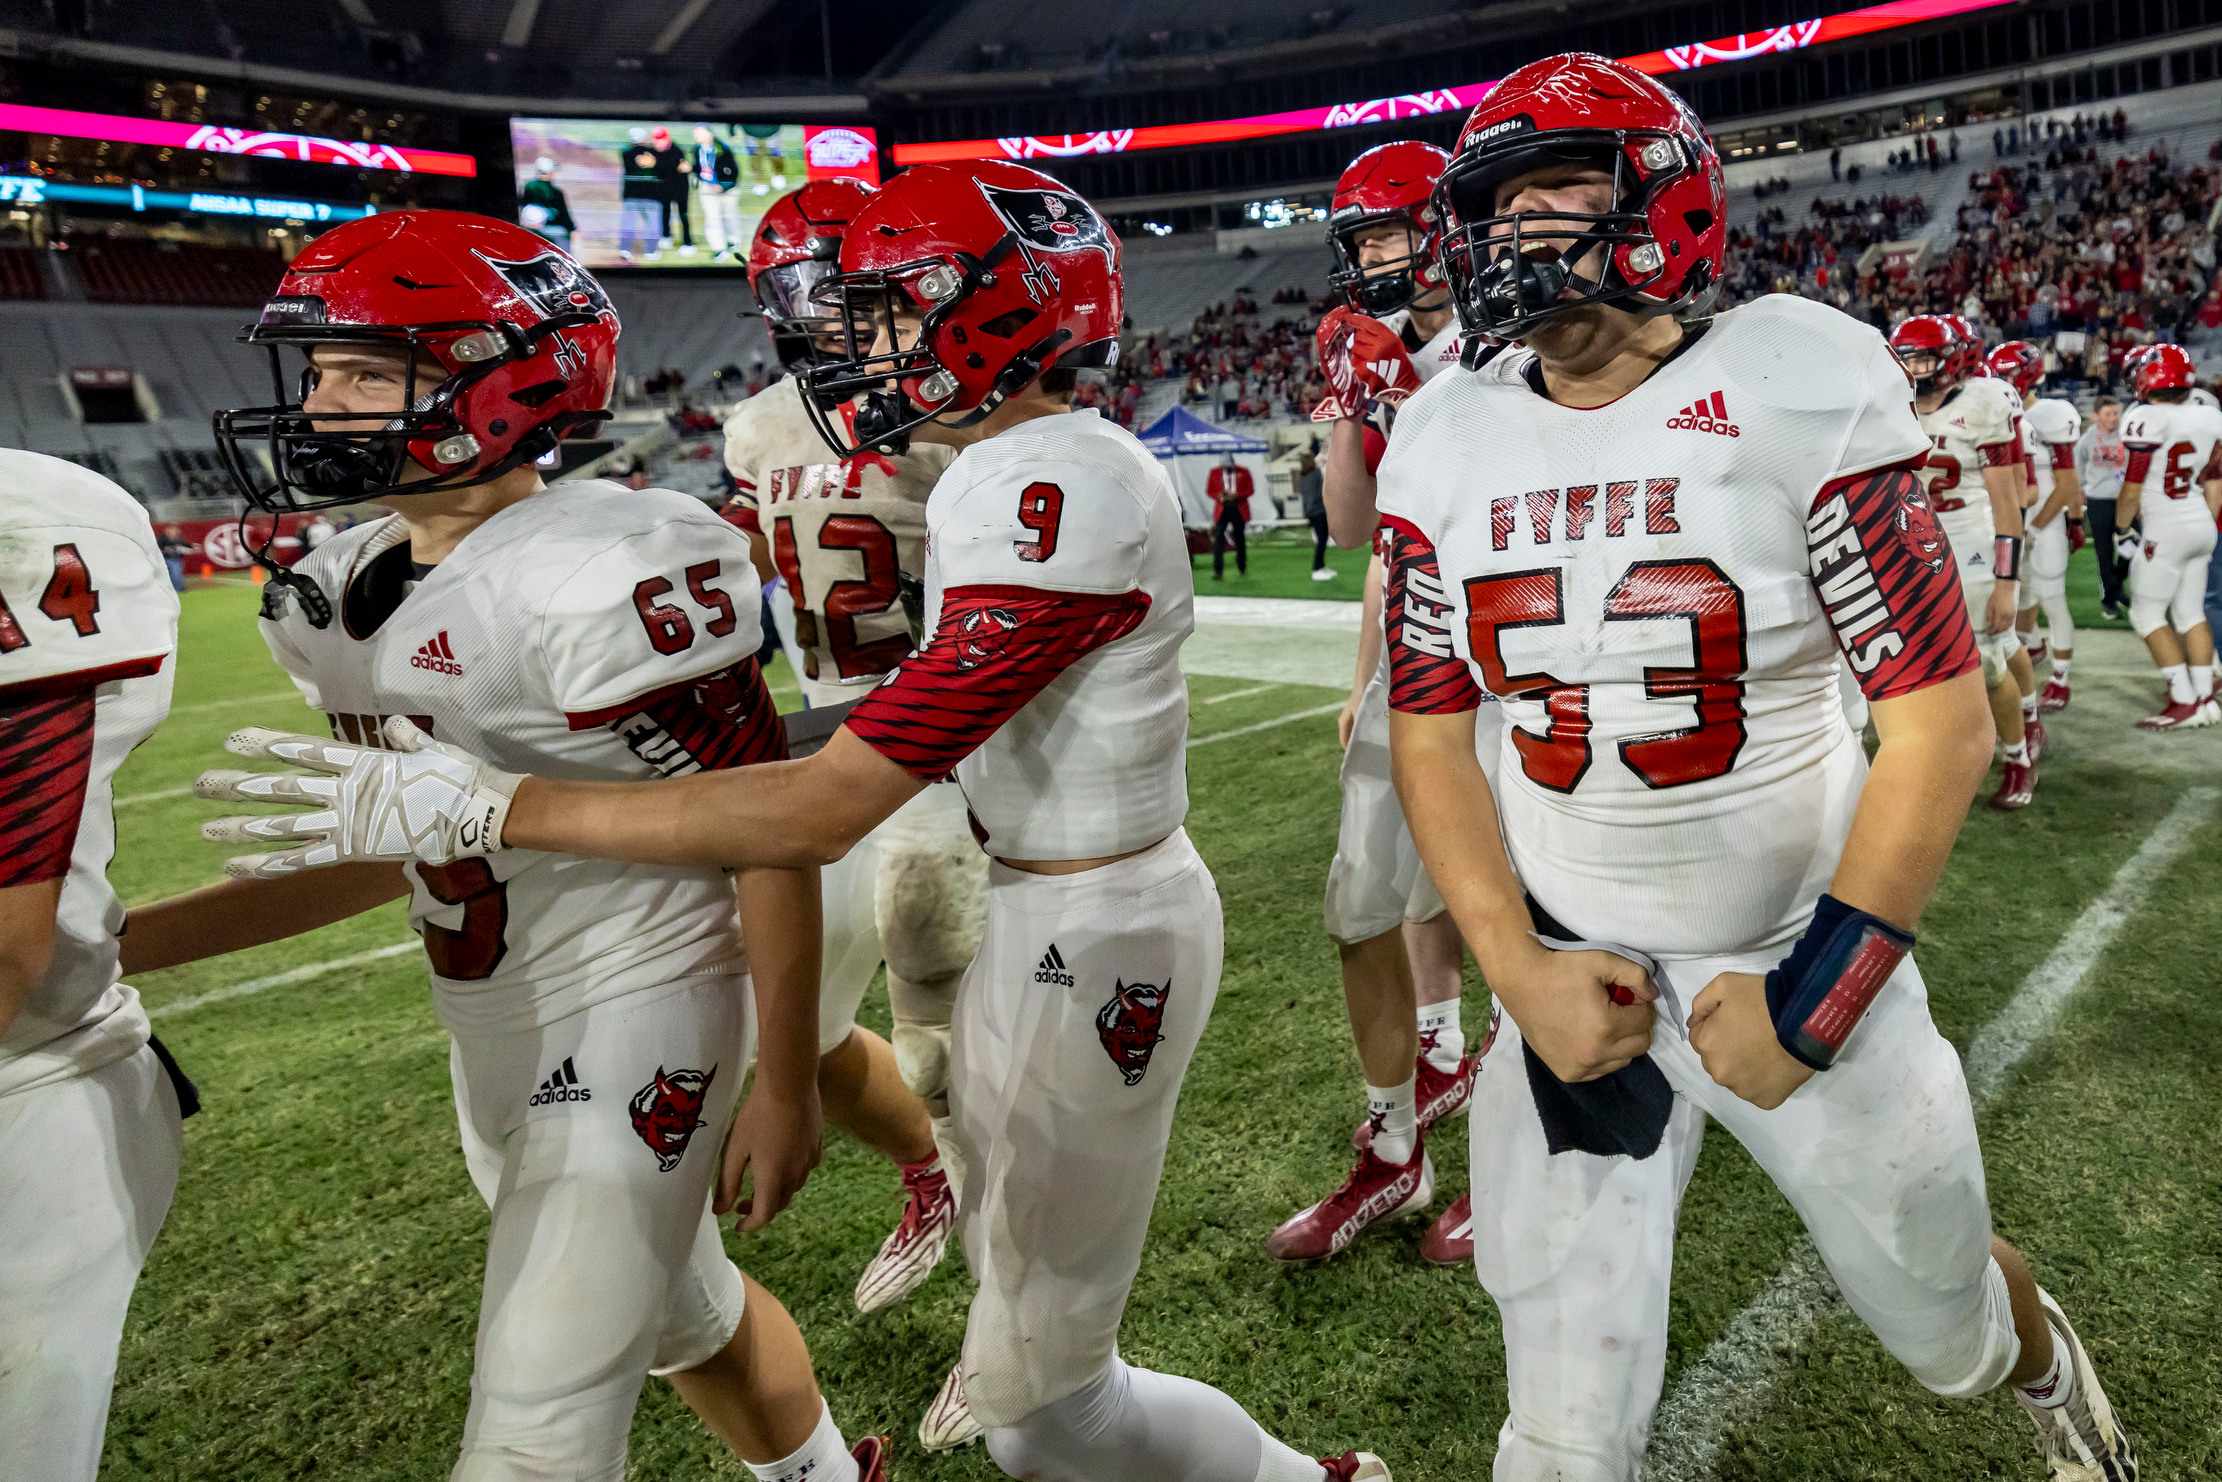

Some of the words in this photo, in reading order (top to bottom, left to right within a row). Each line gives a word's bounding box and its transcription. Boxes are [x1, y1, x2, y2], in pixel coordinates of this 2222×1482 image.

[952, 326, 968, 345] 9
[1075, 302, 1097, 312] Riddell
[1439, 353, 1461, 361] adida
[1666, 414, 1740, 438] adidas
[1013, 481, 1065, 563] 9
[1491, 477, 1682, 552] FYFFE
[632, 559, 738, 656] 65
[773, 513, 916, 683] 12
[1402, 568, 1455, 658] RED
[1805, 493, 1904, 674] DEVILS
[411, 655, 463, 676] adidas
[1462, 557, 1748, 795] 53
[1034, 968, 1074, 988] adidas
[529, 1085, 592, 1108] adidas
[1331, 1172, 1417, 1251] ADIZERO
